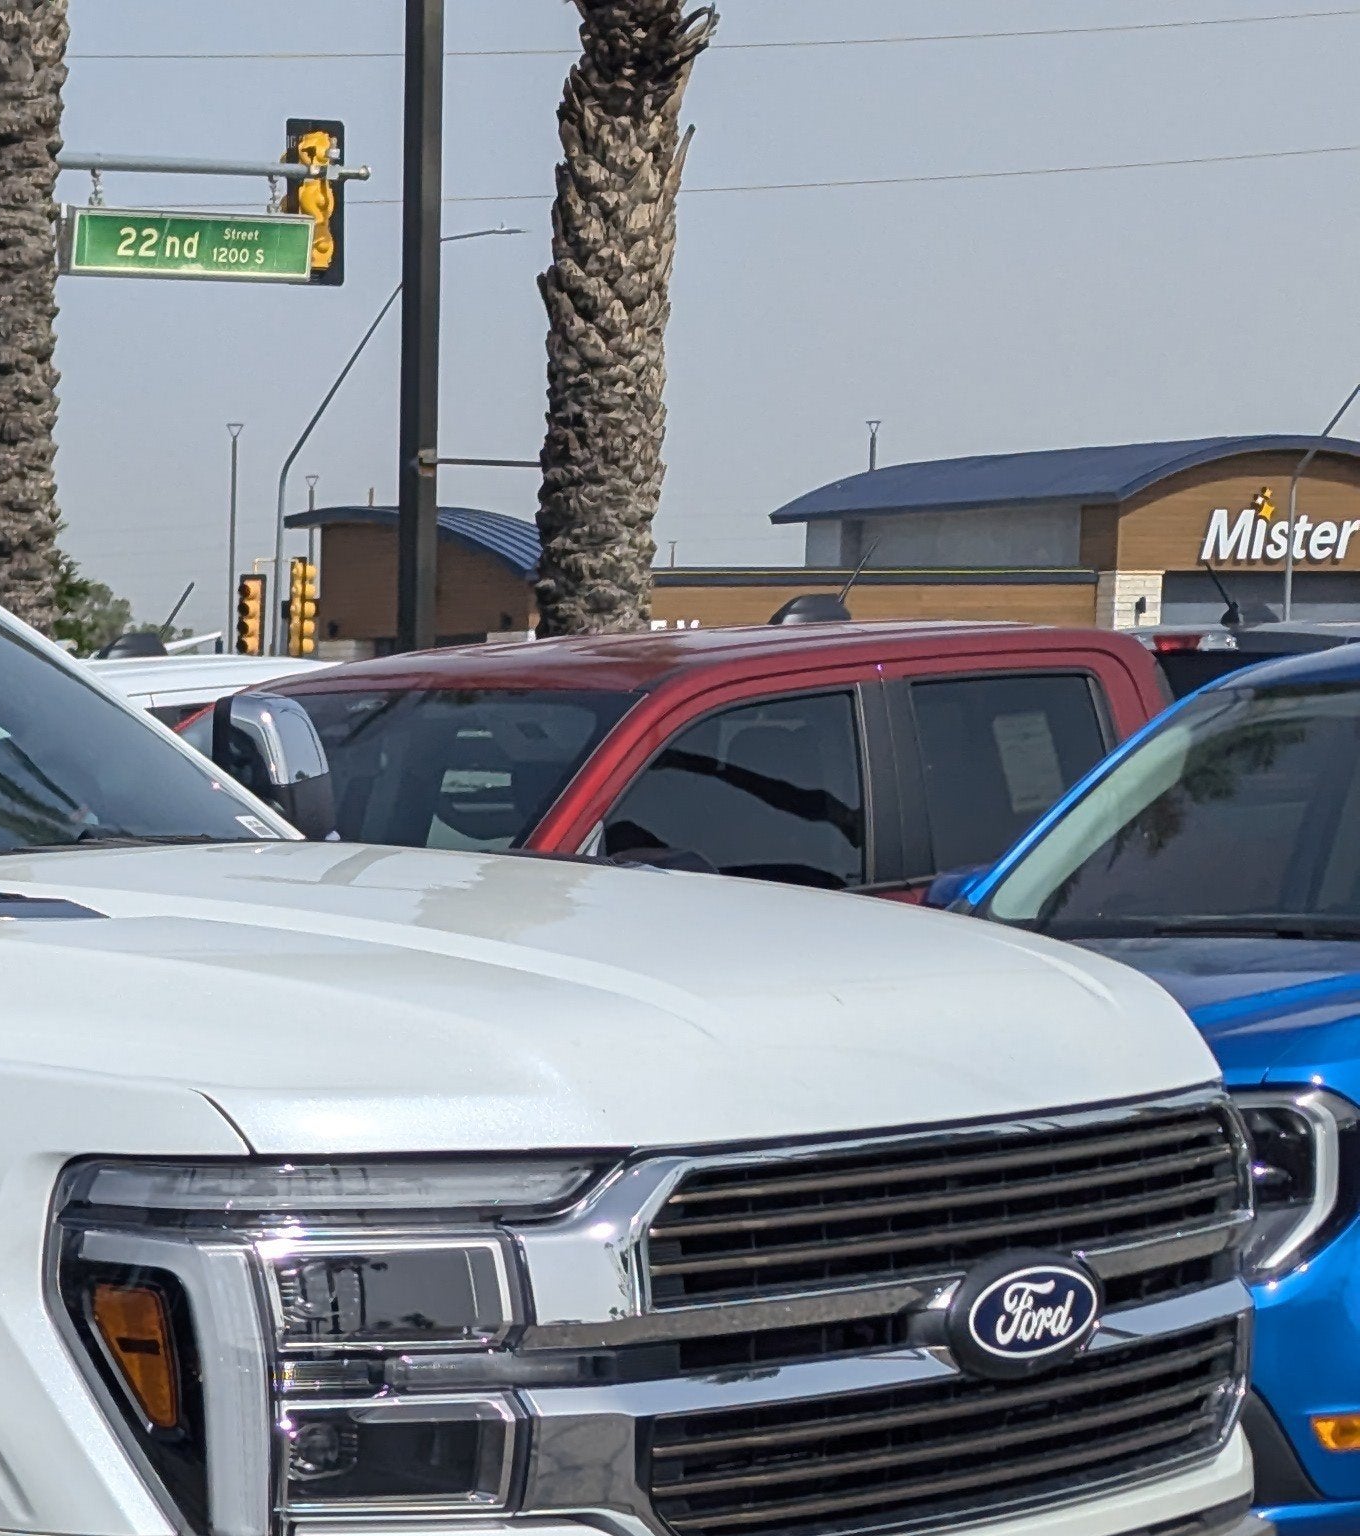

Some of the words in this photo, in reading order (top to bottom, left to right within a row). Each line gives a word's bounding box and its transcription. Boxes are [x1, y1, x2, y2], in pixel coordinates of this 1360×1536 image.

[116, 225, 200, 260] 22nd
[223, 227, 260, 242] Street
[212, 246, 250, 264] 1200
[254, 248, 265, 265] S
[1200, 508, 1360, 561] Mister
[996, 1279, 1075, 1345] Ford
